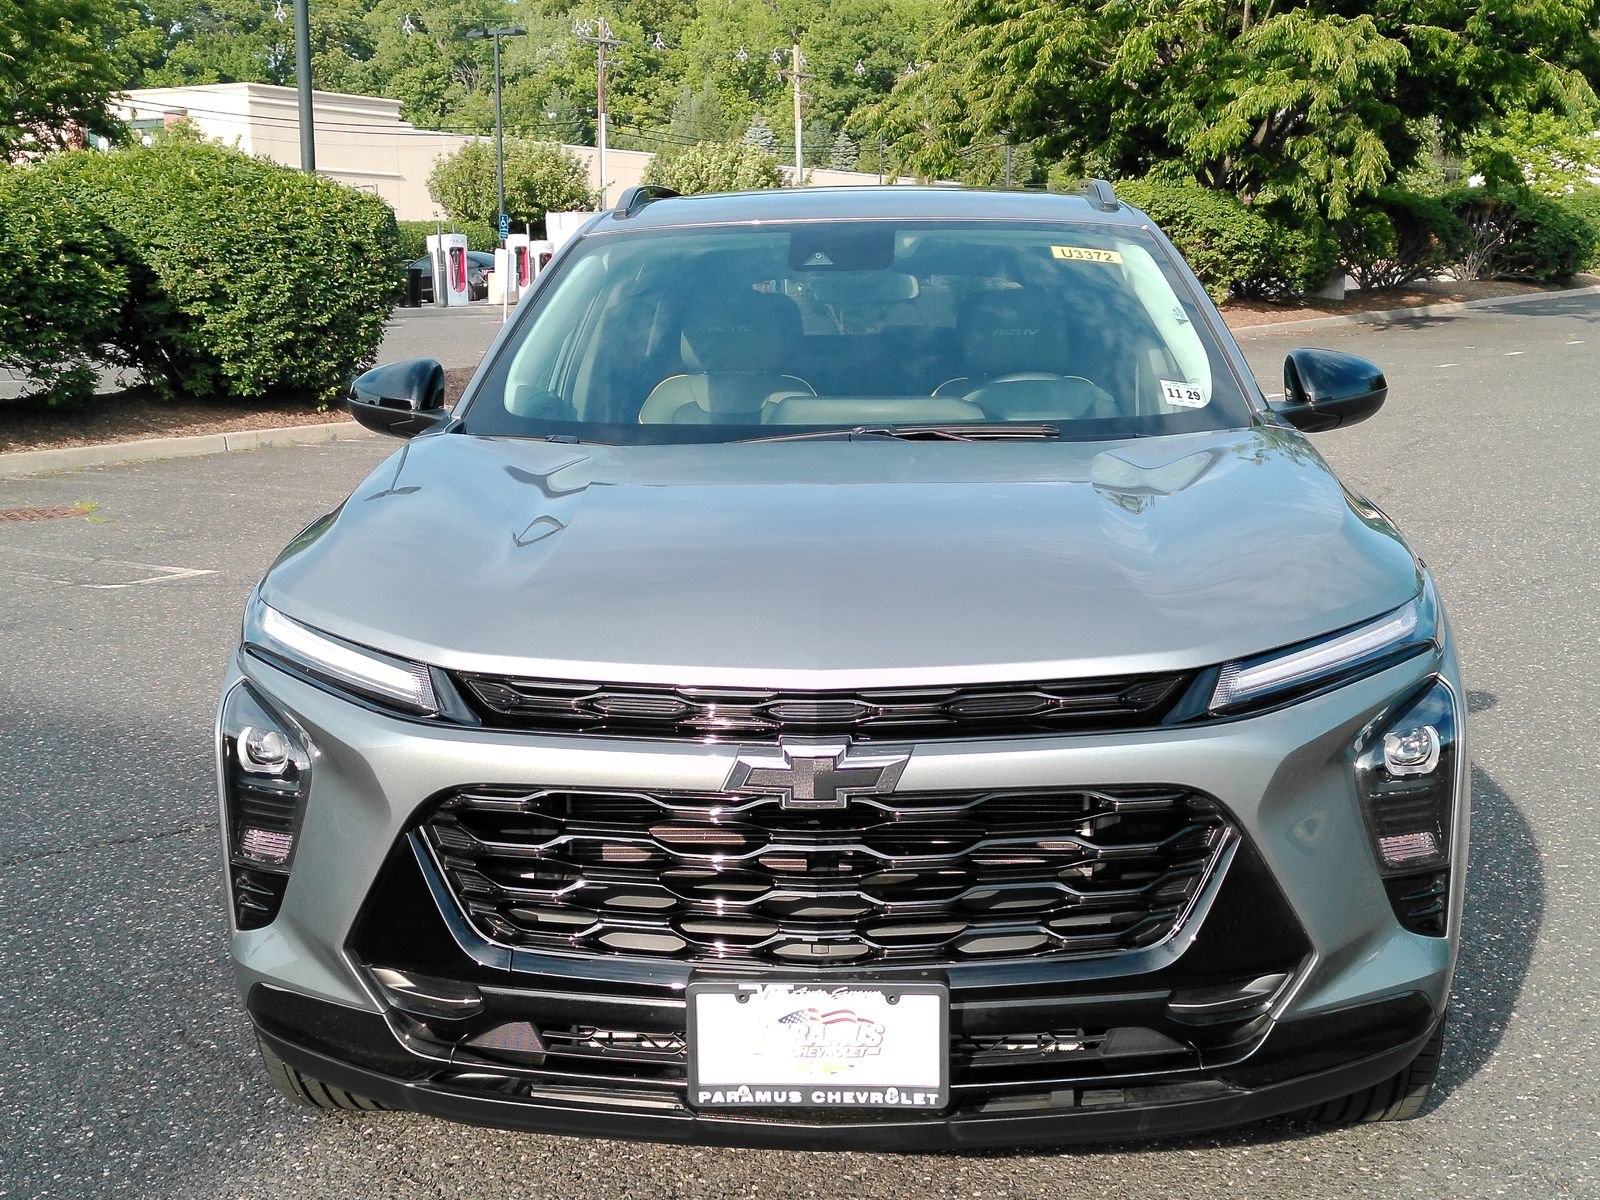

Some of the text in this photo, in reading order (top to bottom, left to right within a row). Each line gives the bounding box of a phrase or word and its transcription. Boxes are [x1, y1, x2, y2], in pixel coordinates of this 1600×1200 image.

[1061, 248, 1114, 262] U3372
[1167, 388, 1201, 401] 11 29
[698, 1085, 939, 1105] PARAMUS CHEVROLET
